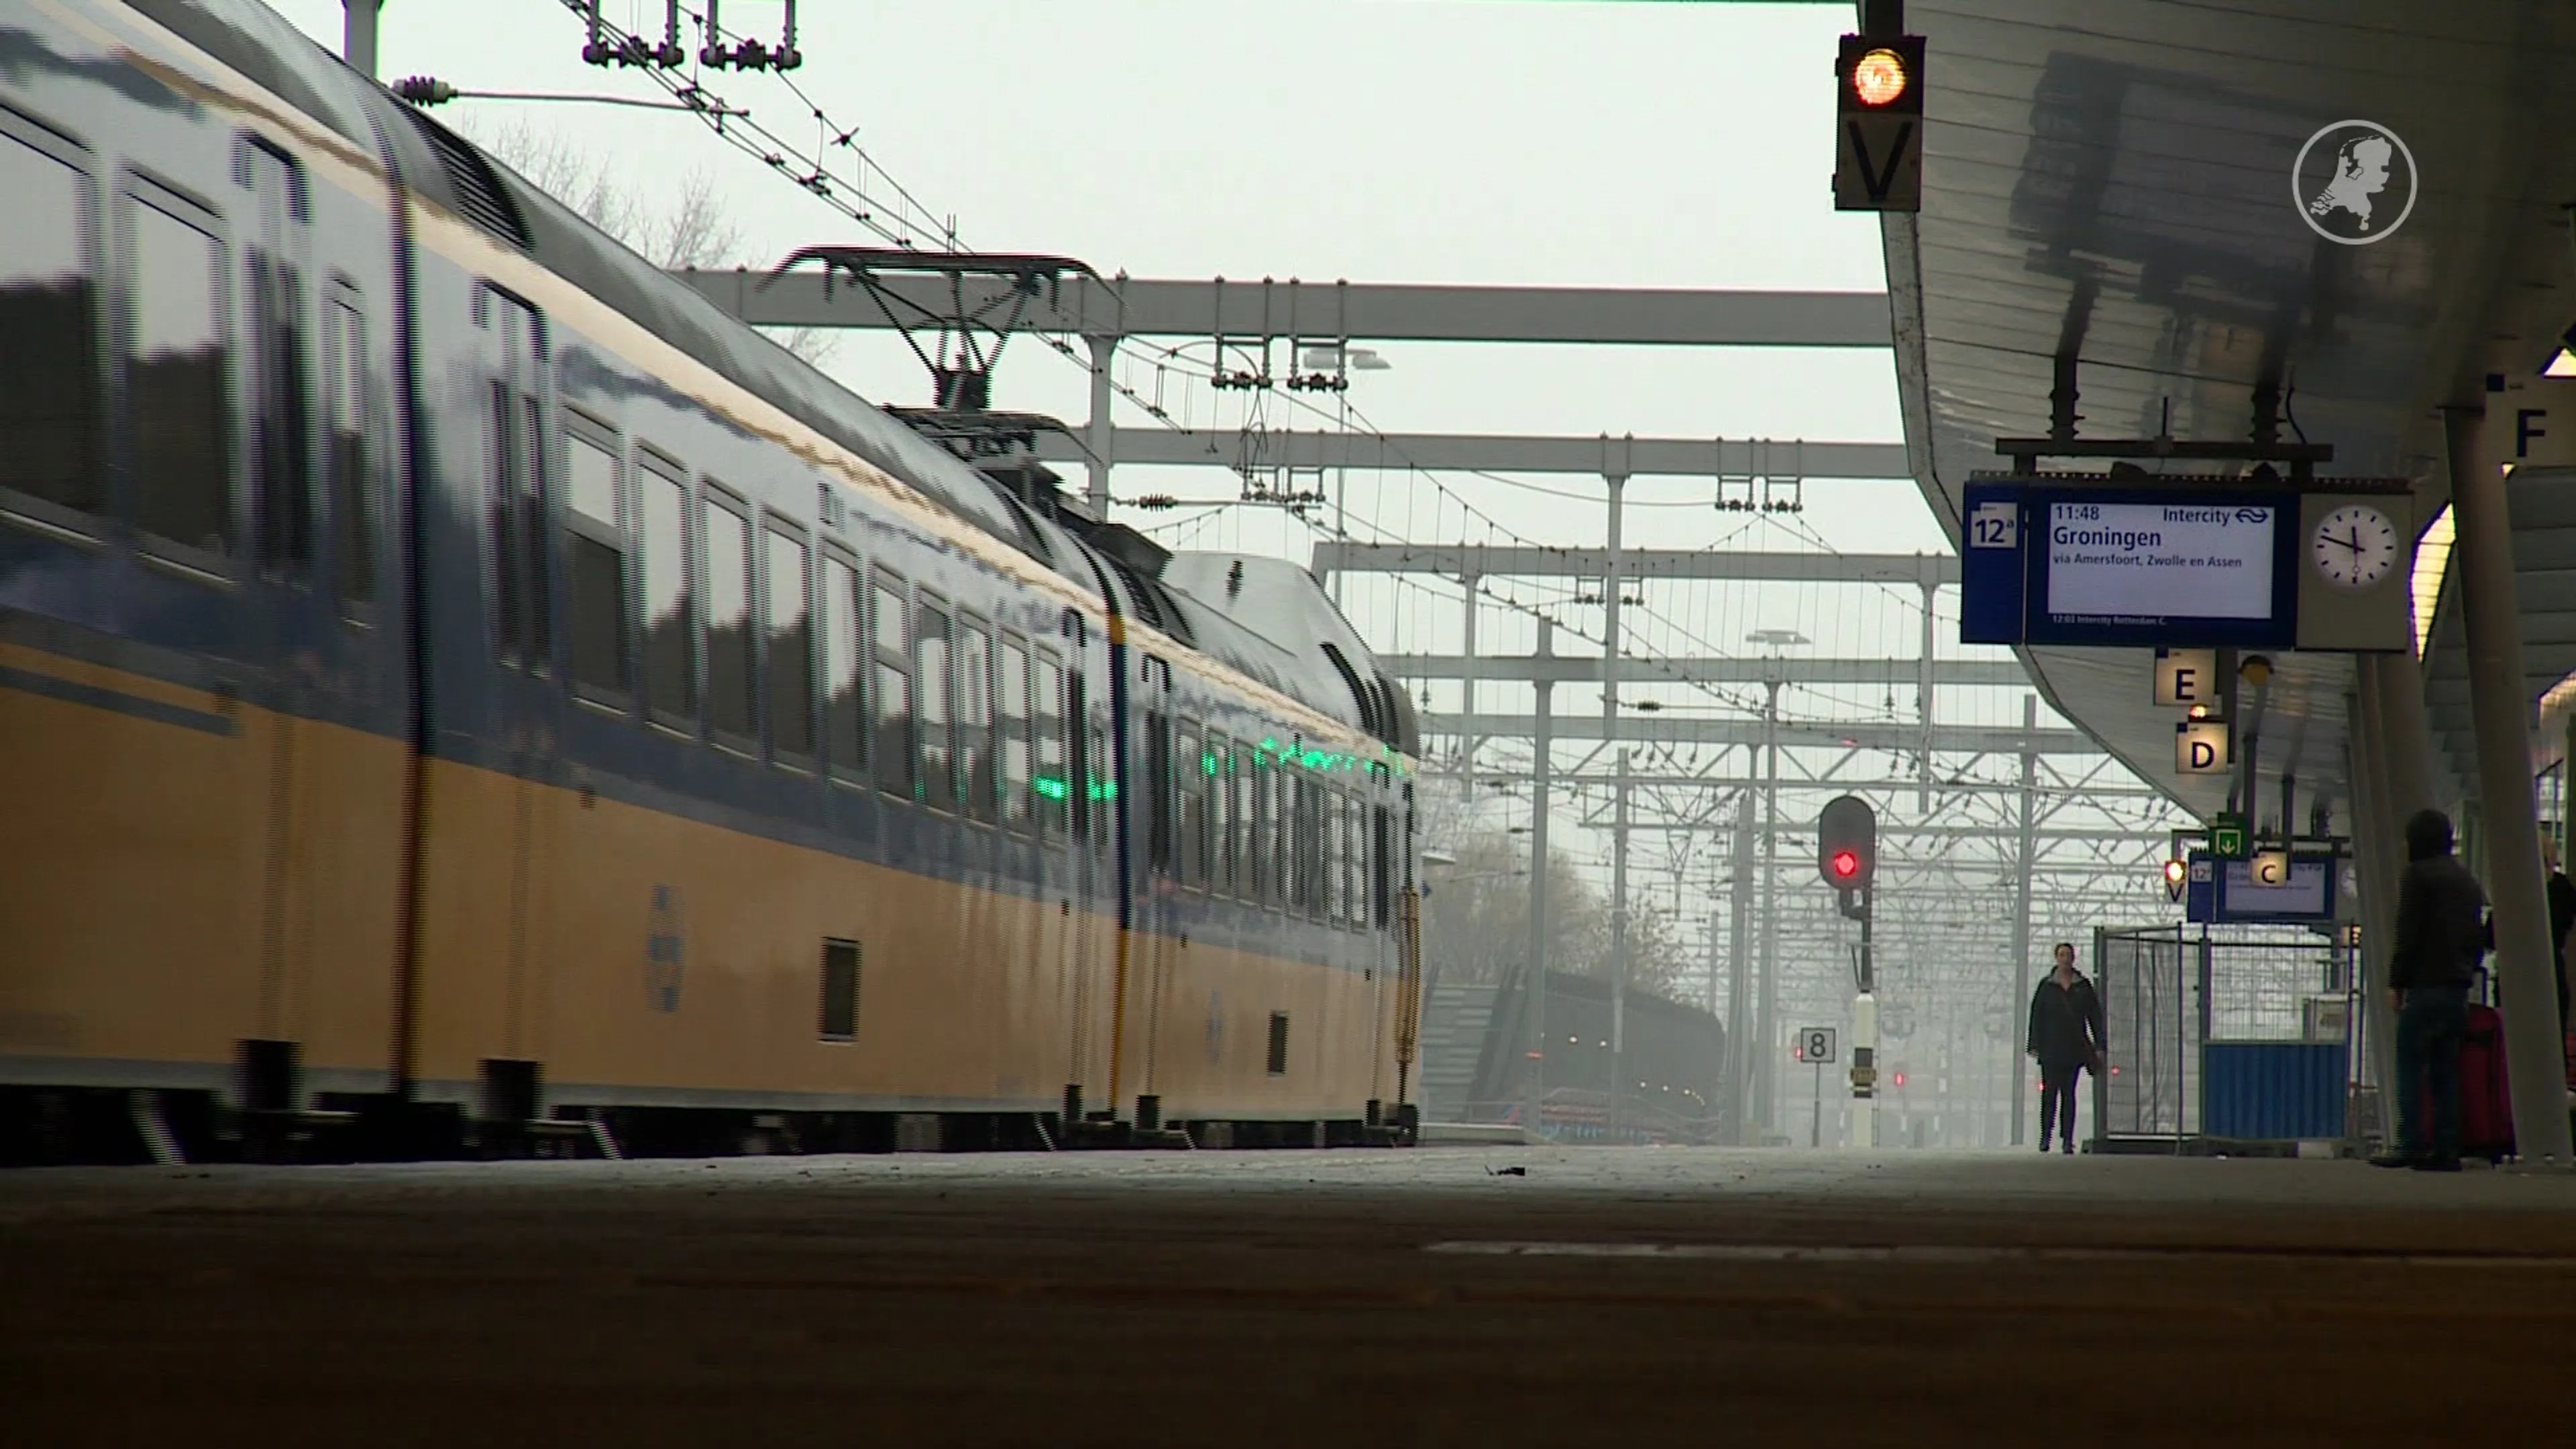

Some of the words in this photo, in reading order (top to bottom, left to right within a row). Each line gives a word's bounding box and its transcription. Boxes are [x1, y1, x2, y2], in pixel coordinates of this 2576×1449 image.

[2517, 409, 2546, 458] F
[2056, 505, 2100, 521] 11:48
[2163, 507, 2231, 527] Intercity
[2053, 525, 2161, 551] Groningen
[2053, 553, 2071, 564] via
[2074, 553, 2143, 566] Amersfoort,
[2147, 554, 2186, 567] Zwolle
[2189, 557, 2204, 567] en
[2207, 556, 2243, 568] Assen
[2175, 669, 2196, 701] E
[2191, 741, 2214, 769] D
[2261, 864, 2276, 884] C
[1811, 1032, 1825, 1058] 8
